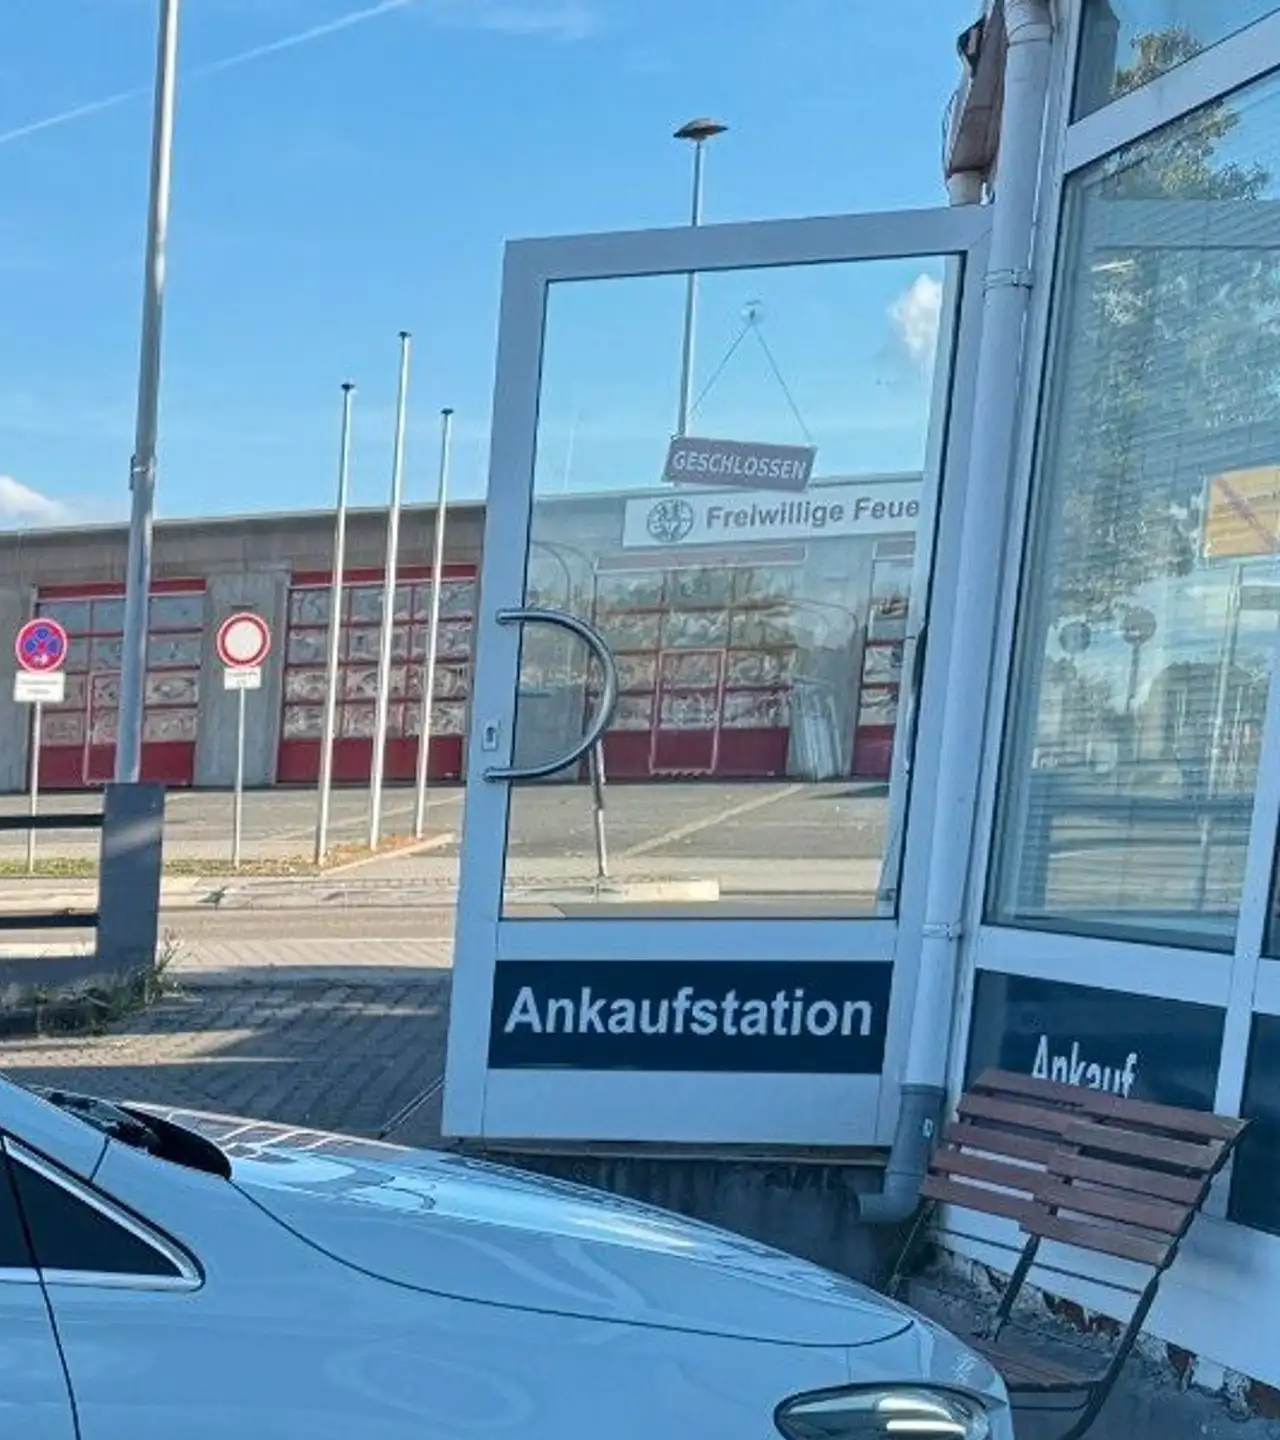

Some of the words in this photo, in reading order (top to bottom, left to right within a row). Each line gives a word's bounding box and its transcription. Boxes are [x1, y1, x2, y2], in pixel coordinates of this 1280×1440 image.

[671, 450, 808, 480] GESCHLOSSEN
[705, 500, 845, 530] Freiwillige
[503, 986, 873, 1037] Ankaufstation
[1031, 1033, 1139, 1099] Ankauf
